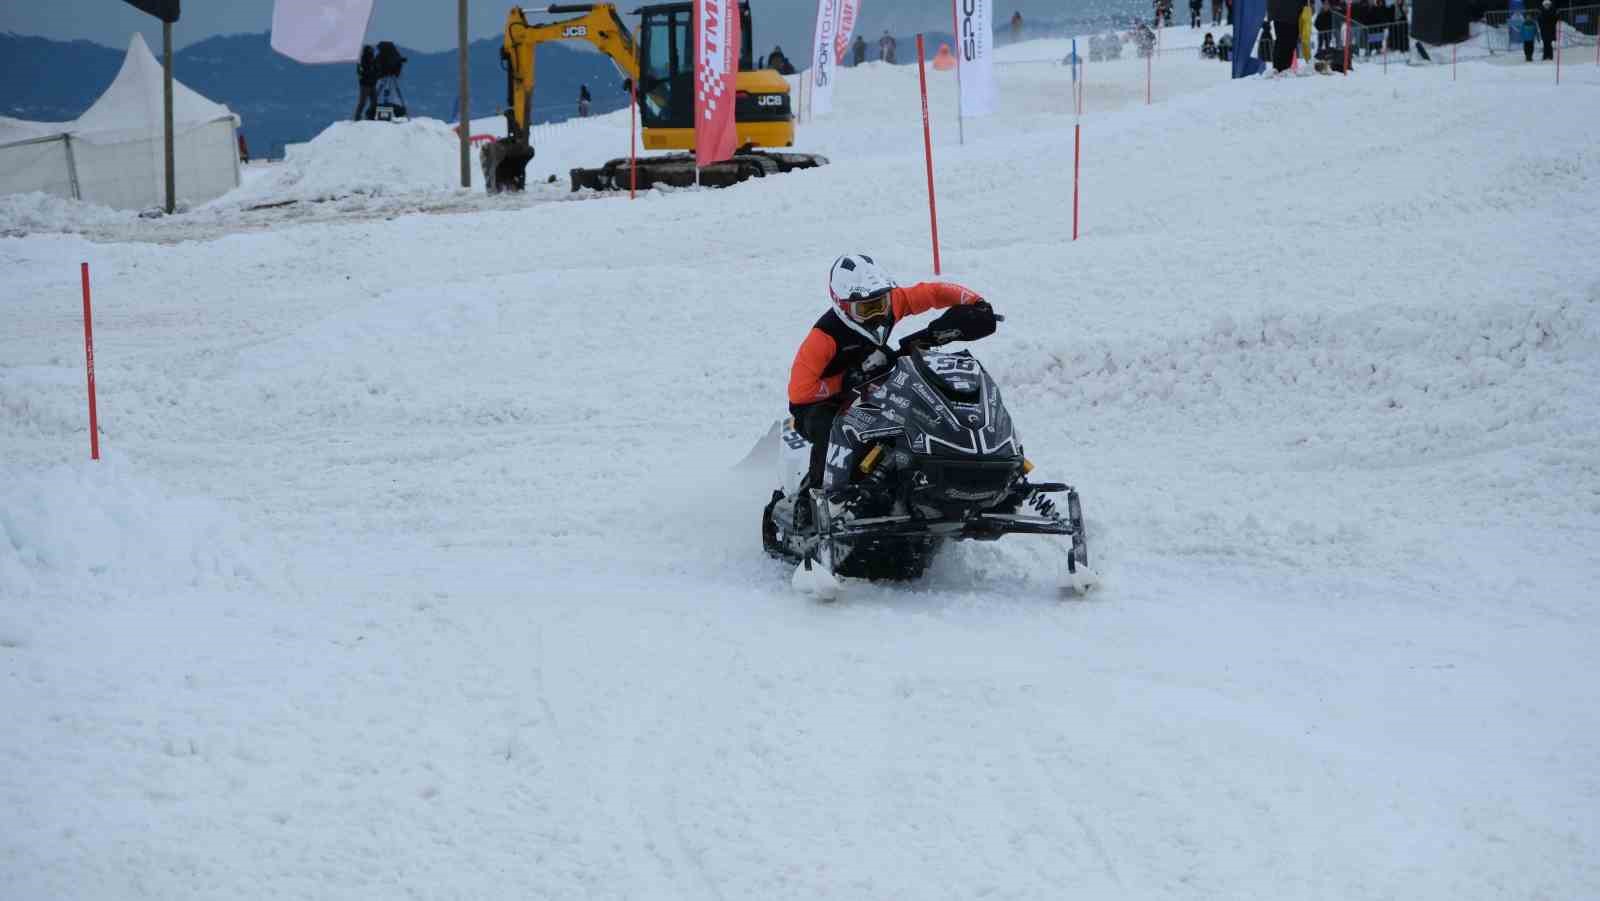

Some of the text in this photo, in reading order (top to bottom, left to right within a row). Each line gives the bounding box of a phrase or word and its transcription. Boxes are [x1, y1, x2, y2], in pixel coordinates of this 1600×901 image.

[562, 26, 586, 37] JCB
[704, 0, 719, 55] TM
[758, 95, 782, 106] JCB
